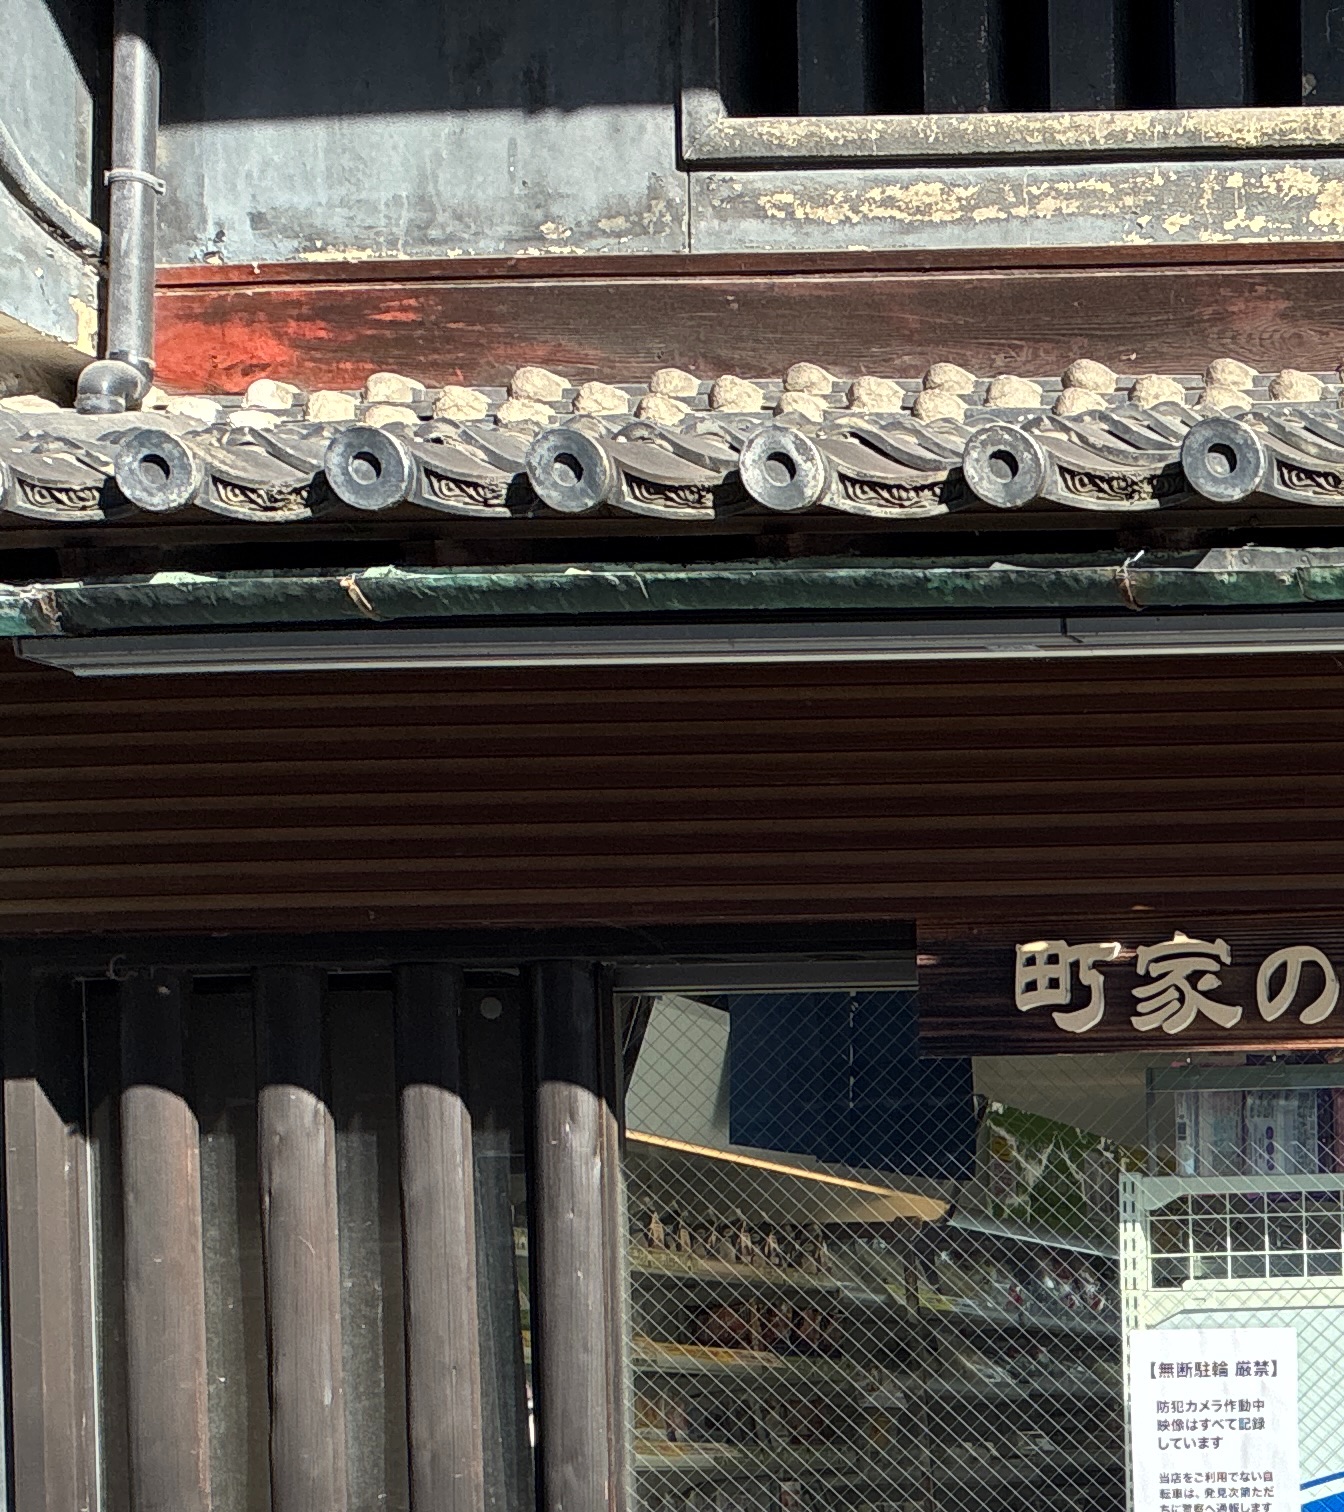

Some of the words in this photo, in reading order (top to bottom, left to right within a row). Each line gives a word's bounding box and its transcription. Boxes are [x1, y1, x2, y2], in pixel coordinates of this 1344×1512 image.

[1156, 1399, 1265, 1413] 防犯カメラ作動中
[1157, 1417, 1265, 1432] 映像はすべて記録
[1158, 1436, 1223, 1450] しています
[1159, 1471, 1273, 1484] 当店をご利用でない自
